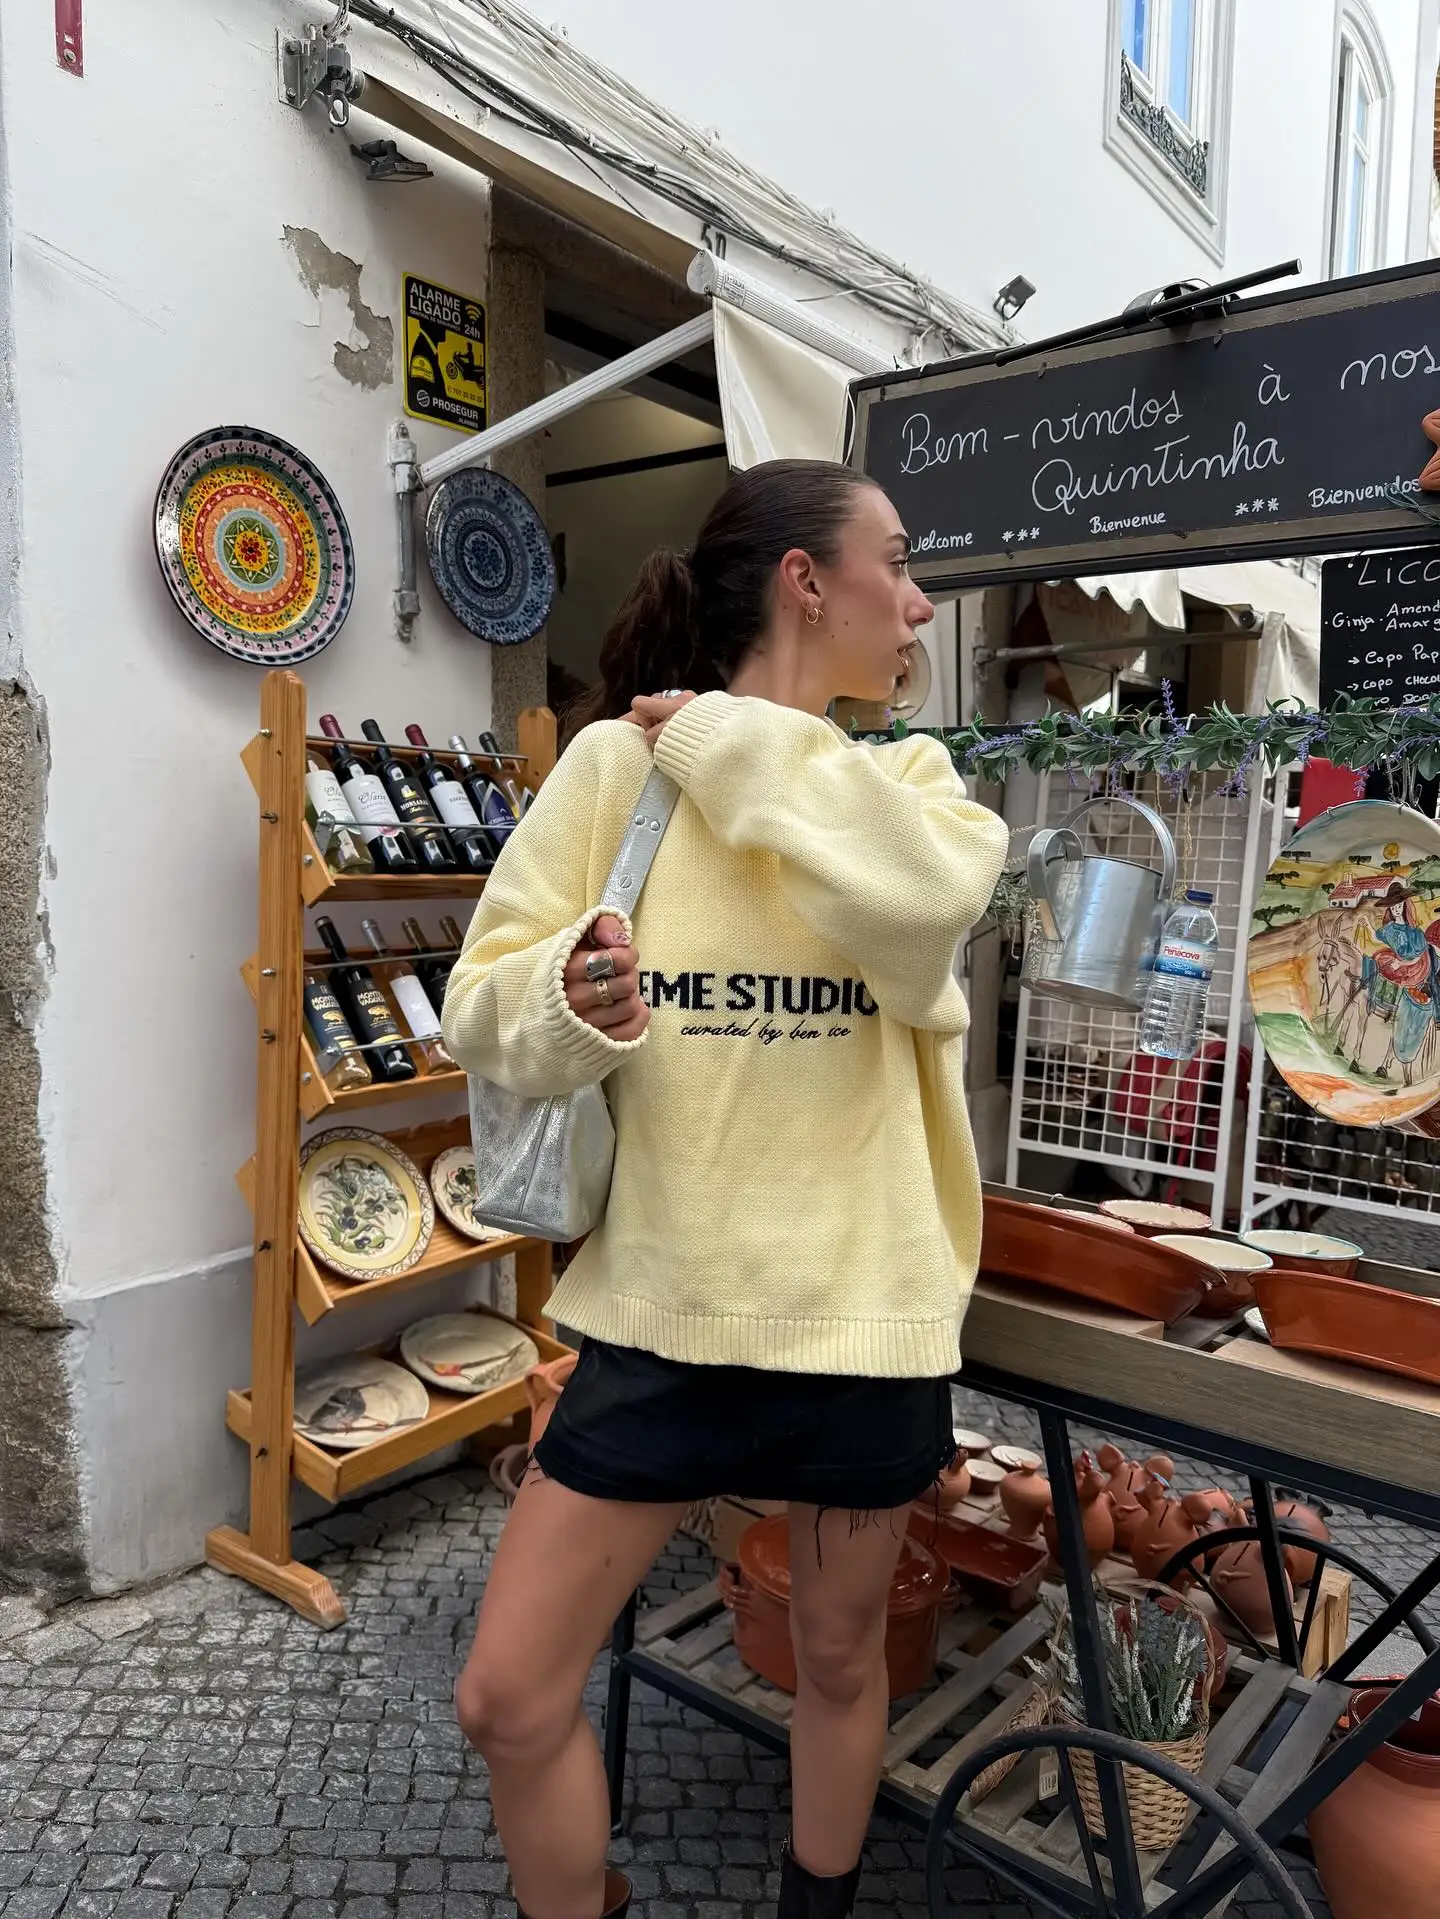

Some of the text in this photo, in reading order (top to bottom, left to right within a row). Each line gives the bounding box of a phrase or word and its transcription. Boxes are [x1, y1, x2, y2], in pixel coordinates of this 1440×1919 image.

[409, 294, 461, 325] LIGADO
[410, 282, 461, 312] ALARME
[464, 325, 480, 339] 24h
[432, 397, 479, 420] PROSEGUR
[900, 413, 989, 474] Bem
[1031, 387, 1184, 450] vindos
[1258, 363, 1291, 405] à
[1031, 421, 1285, 515] Quintinha
[1089, 511, 1167, 535] Bienvenue
[1365, 651, 1403, 668] Copo
[1164, 945, 1201, 960] Penacova
[681, 1018, 852, 1045] curated by ben ice
